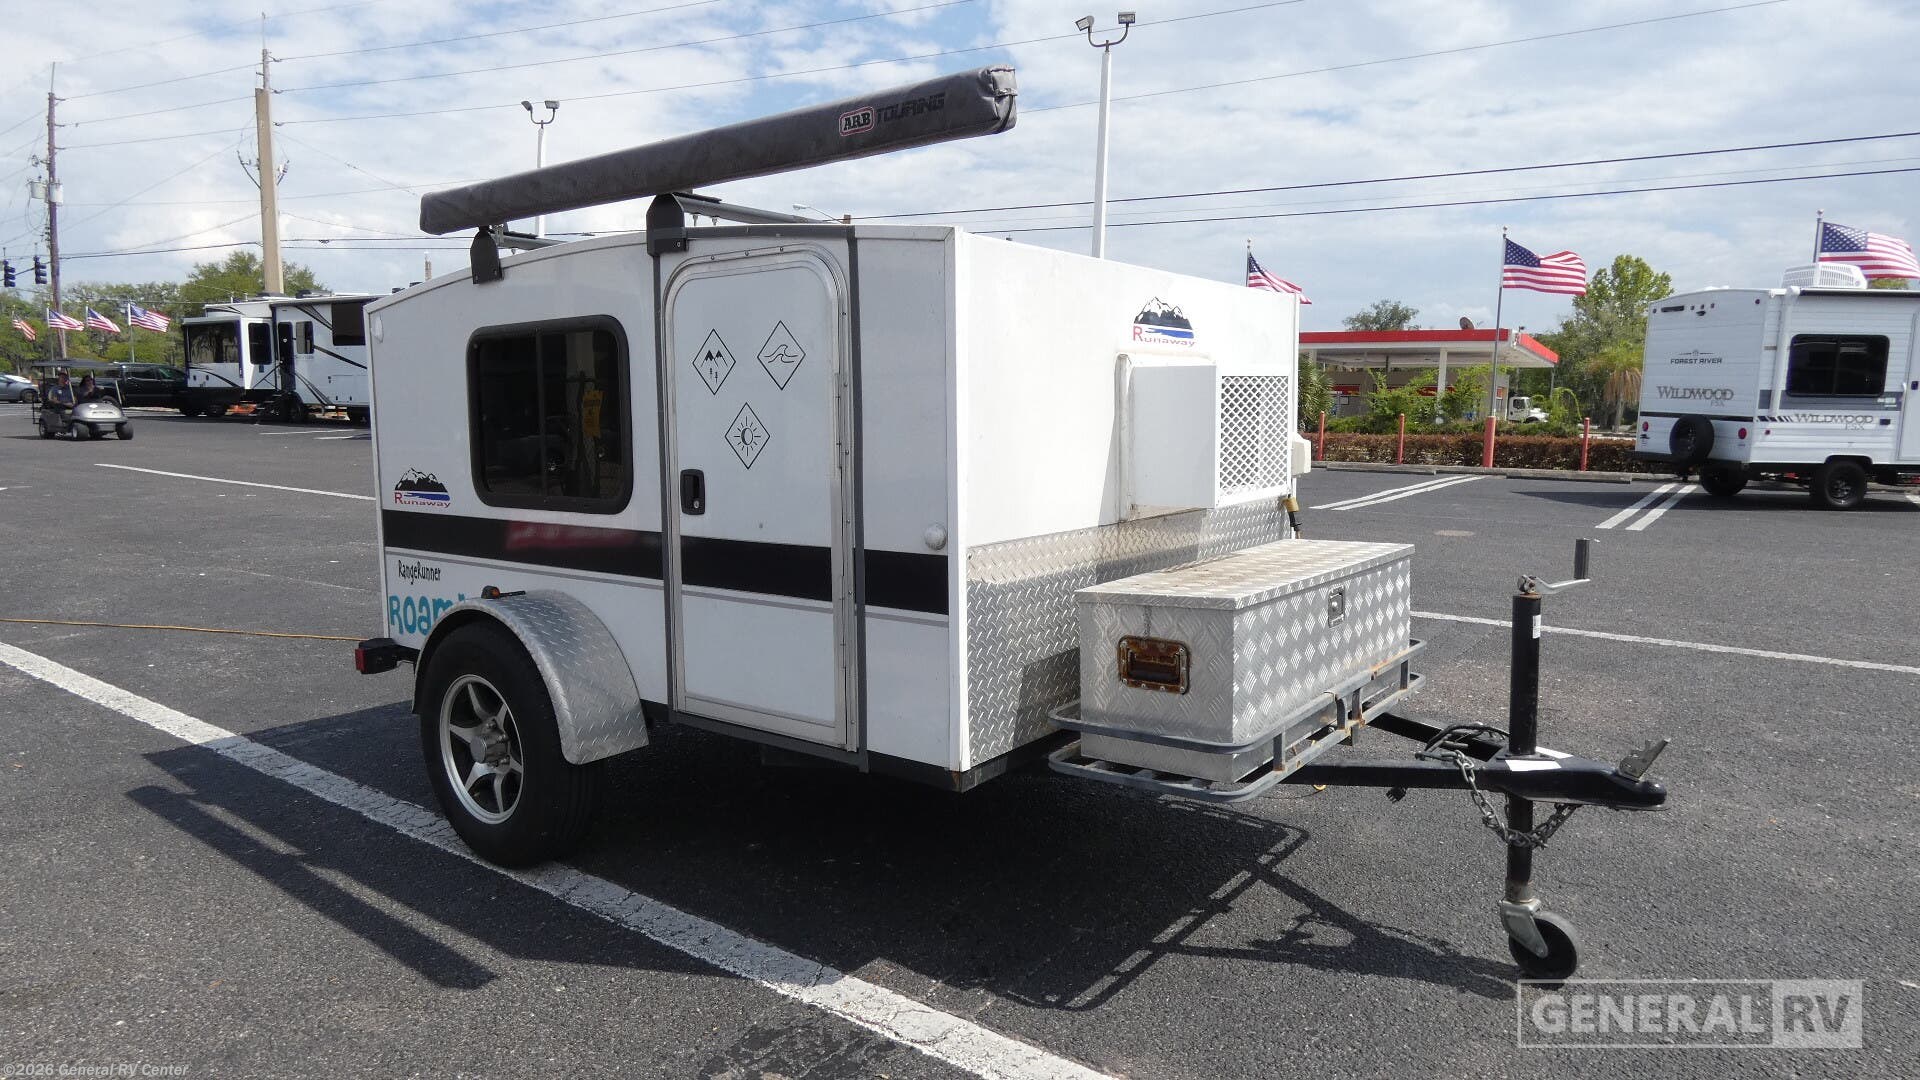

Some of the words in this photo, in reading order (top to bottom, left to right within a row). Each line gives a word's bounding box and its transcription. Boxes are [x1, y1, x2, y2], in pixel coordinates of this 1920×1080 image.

[843, 112, 871, 131] ARB
[876, 92, 946, 123] TOURING
[1132, 325, 1196, 347] Runaway
[394, 491, 451, 508] Runaway
[398, 559, 441, 585] RangeRunner
